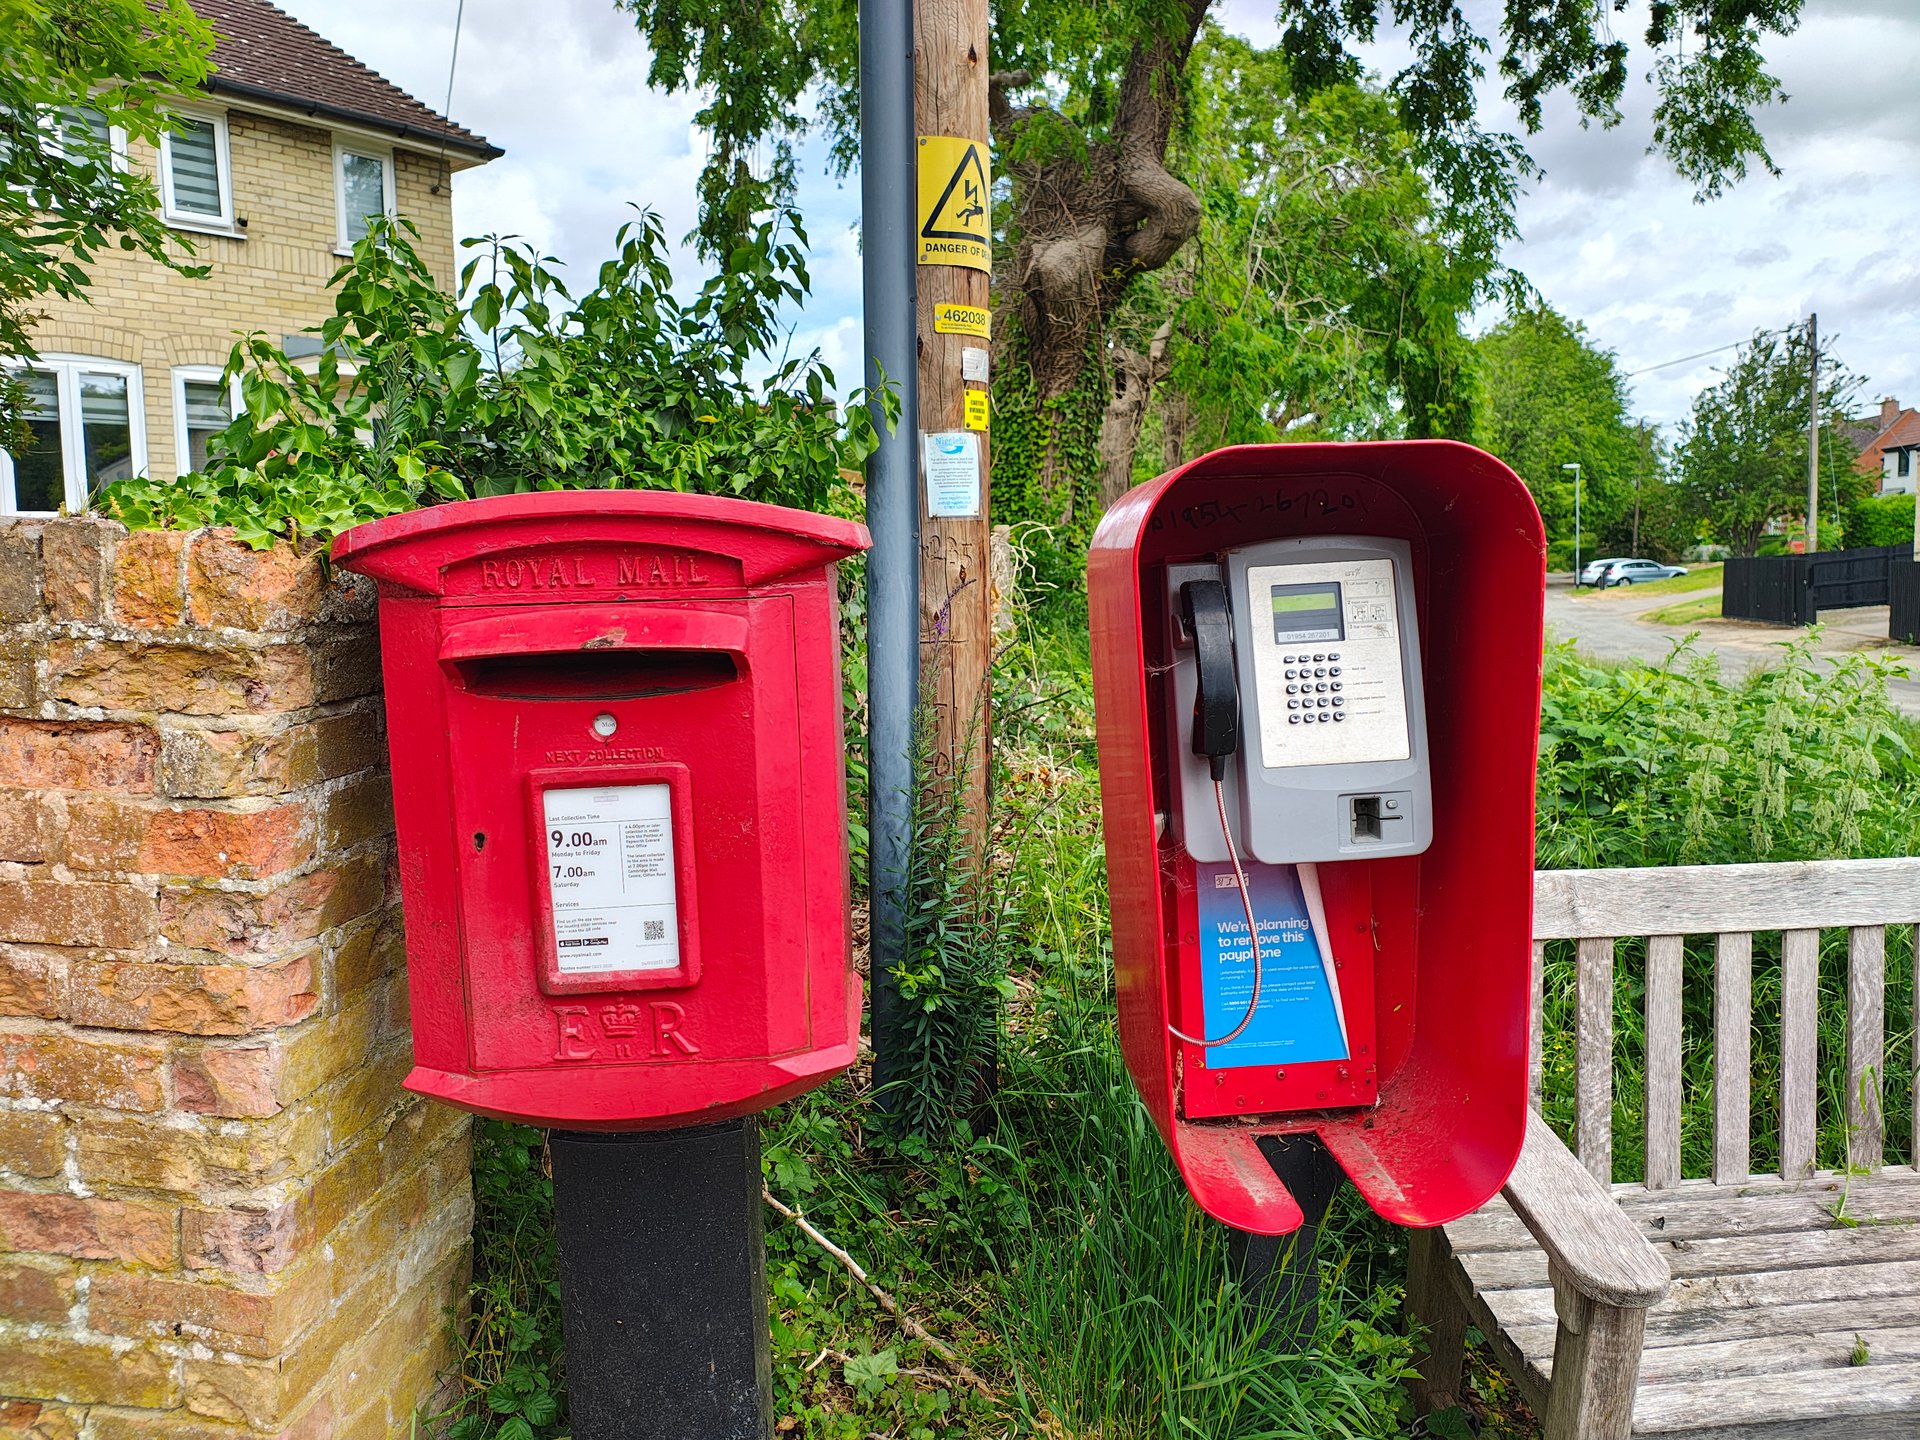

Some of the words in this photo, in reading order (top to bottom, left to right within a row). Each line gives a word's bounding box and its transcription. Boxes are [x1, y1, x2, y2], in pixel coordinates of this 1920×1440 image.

[926, 243, 967, 254] DANGER
[970, 246, 980, 256] OF
[944, 309, 986, 325] 462038
[480, 556, 596, 589] ROYAL
[616, 554, 710, 586] MAIL
[546, 750, 580, 763] NEXT
[588, 747, 664, 761] COLLECTION
[551, 830, 607, 848] 9.00am
[553, 866, 595, 878] 7.00am
[1256, 918, 1309, 933] planning
[1218, 936, 1231, 947] to
[1282, 931, 1304, 943] this
[552, 1005, 598, 1061] E
[649, 1002, 700, 1056] R
